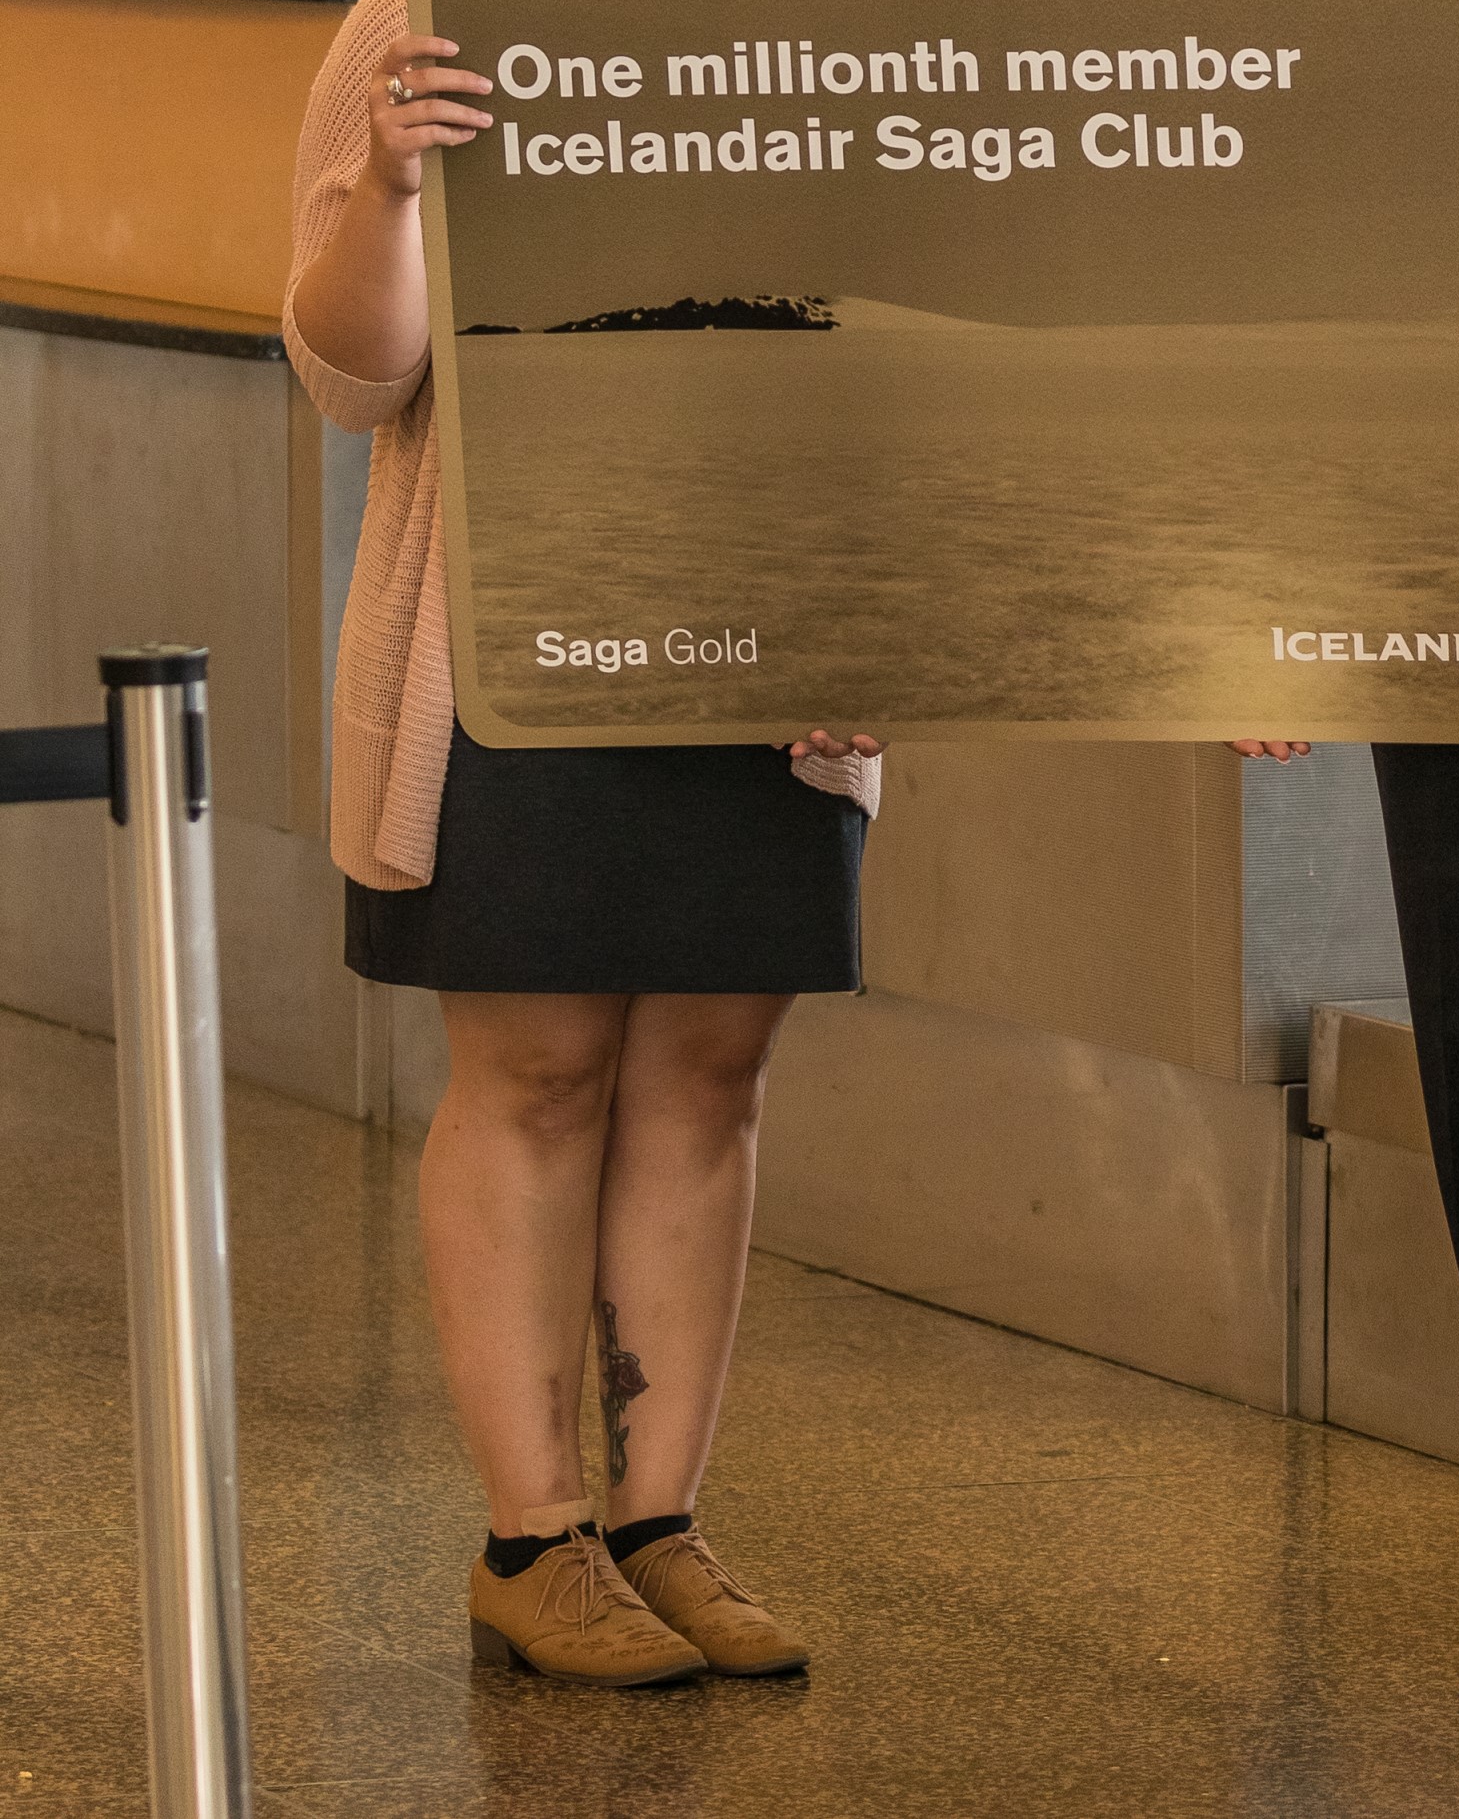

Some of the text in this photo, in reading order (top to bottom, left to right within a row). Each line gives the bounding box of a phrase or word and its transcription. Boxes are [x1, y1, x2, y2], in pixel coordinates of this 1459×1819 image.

[496, 36, 1302, 100] One millionth member
[502, 112, 1245, 183] Icelandair Saga Club
[535, 628, 758, 673] Saga Gold
